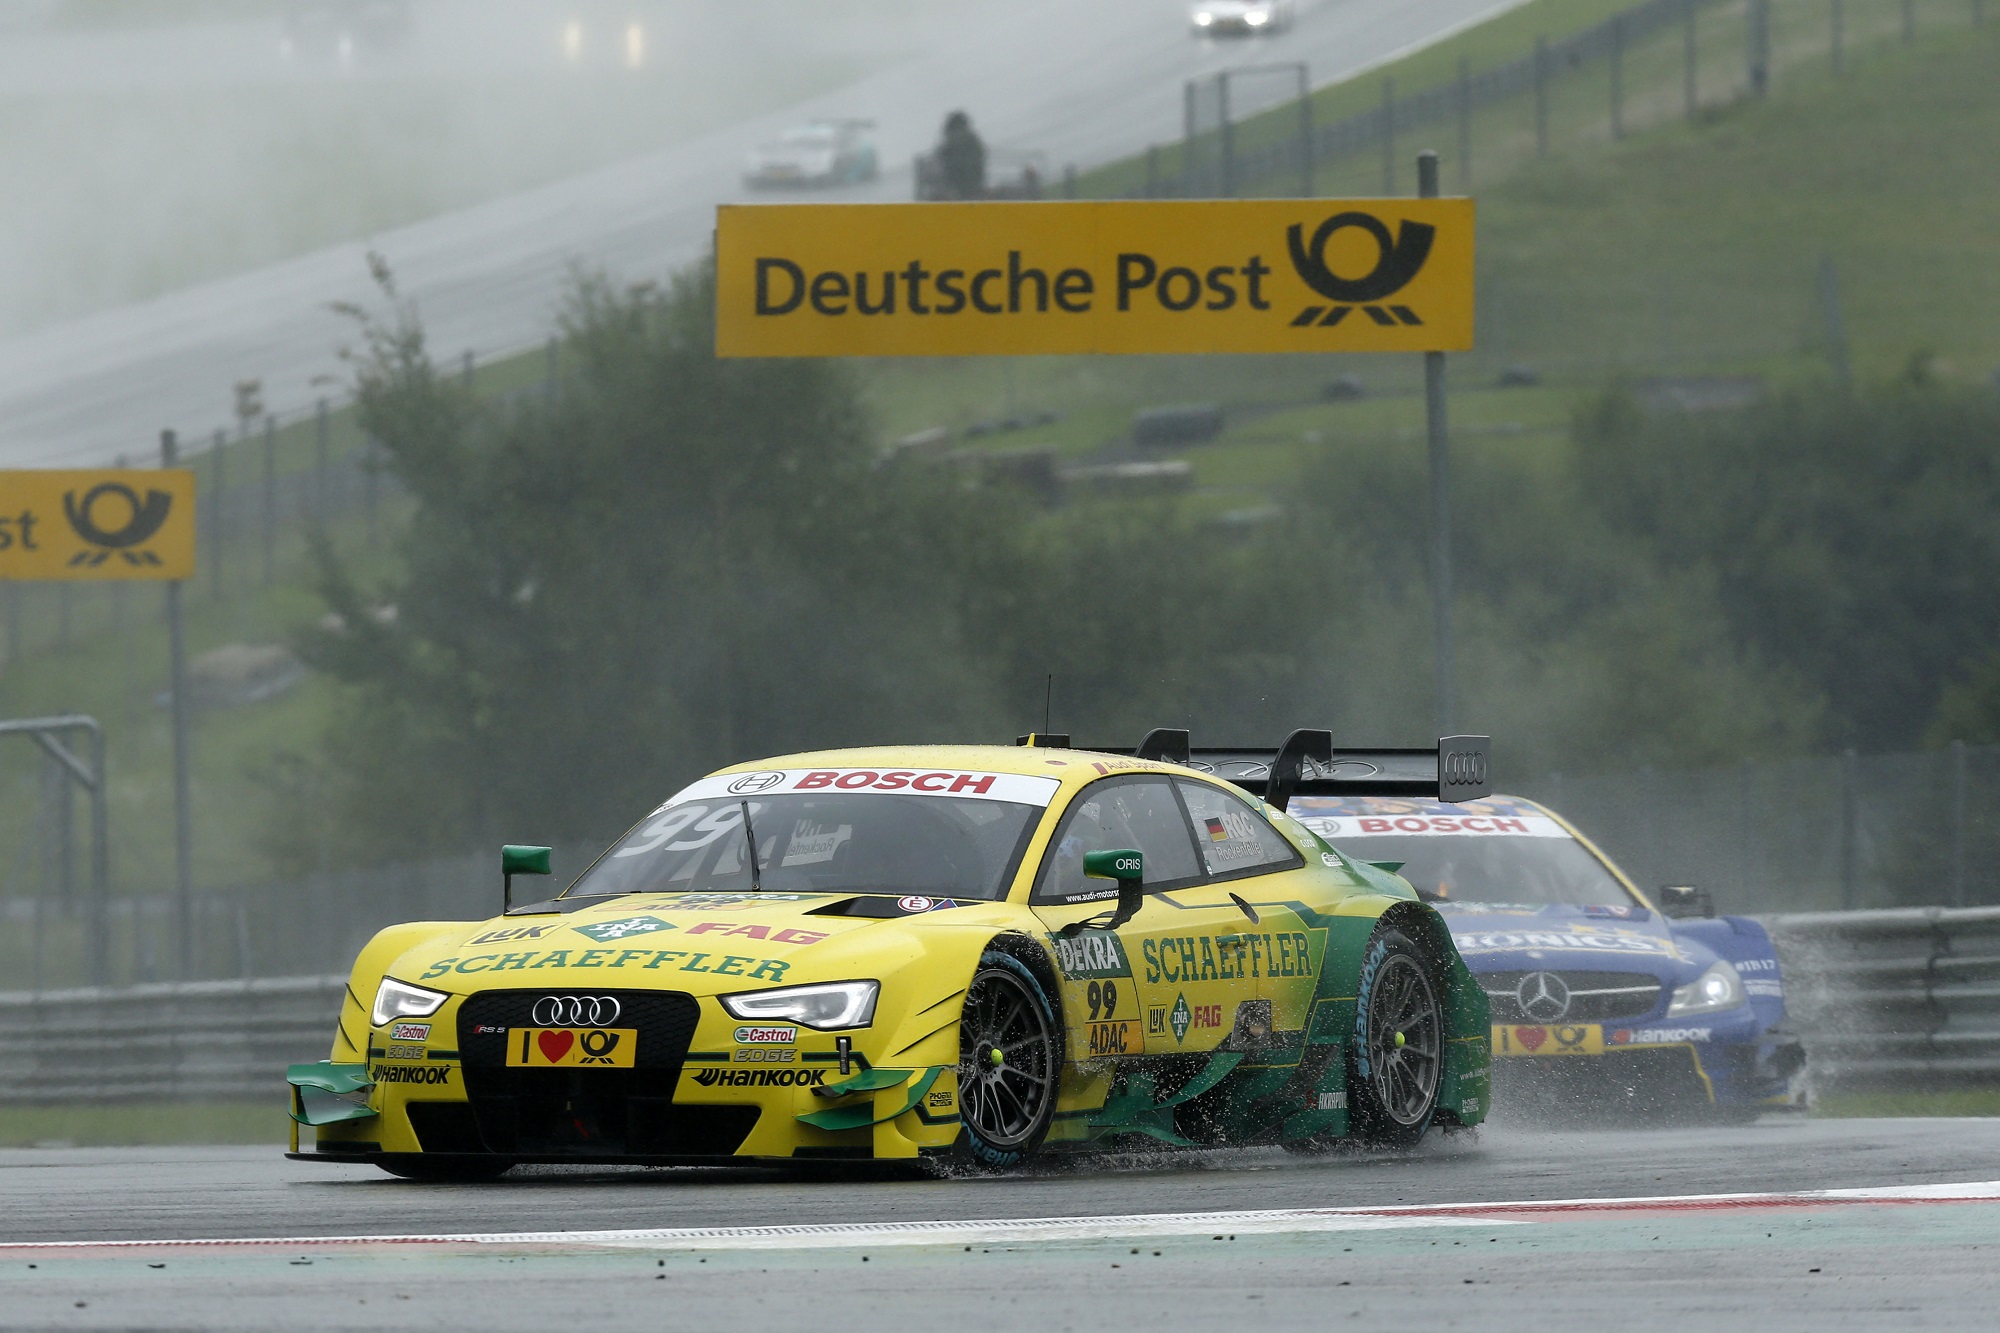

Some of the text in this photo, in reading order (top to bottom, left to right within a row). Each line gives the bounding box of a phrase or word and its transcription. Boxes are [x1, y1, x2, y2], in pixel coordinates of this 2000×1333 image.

[755, 250, 1271, 316] Deutsche Post
[793, 771, 997, 794] BOSCH
[612, 802, 762, 858] 99
[1220, 811, 1255, 839] ROC
[1358, 817, 1530, 832] BOSCH
[1215, 840, 1262, 860] Rockenfeller
[1115, 858, 1141, 870] ORIS
[684, 922, 831, 945] FAG
[419, 949, 792, 983] SCHAEFFLER
[1058, 935, 1122, 972] DEKRA
[1142, 931, 1313, 984] SCHAEFFLER
[1087, 980, 1117, 1020] 99
[1193, 1004, 1222, 1029] FAG
[398, 1025, 429, 1039] Castrol
[749, 1027, 793, 1042] Castrol
[1088, 1023, 1128, 1055] ADAC
[387, 1045, 426, 1059] EDGE
[521, 1030, 531, 1063] I
[733, 1048, 797, 1063] EDGE
